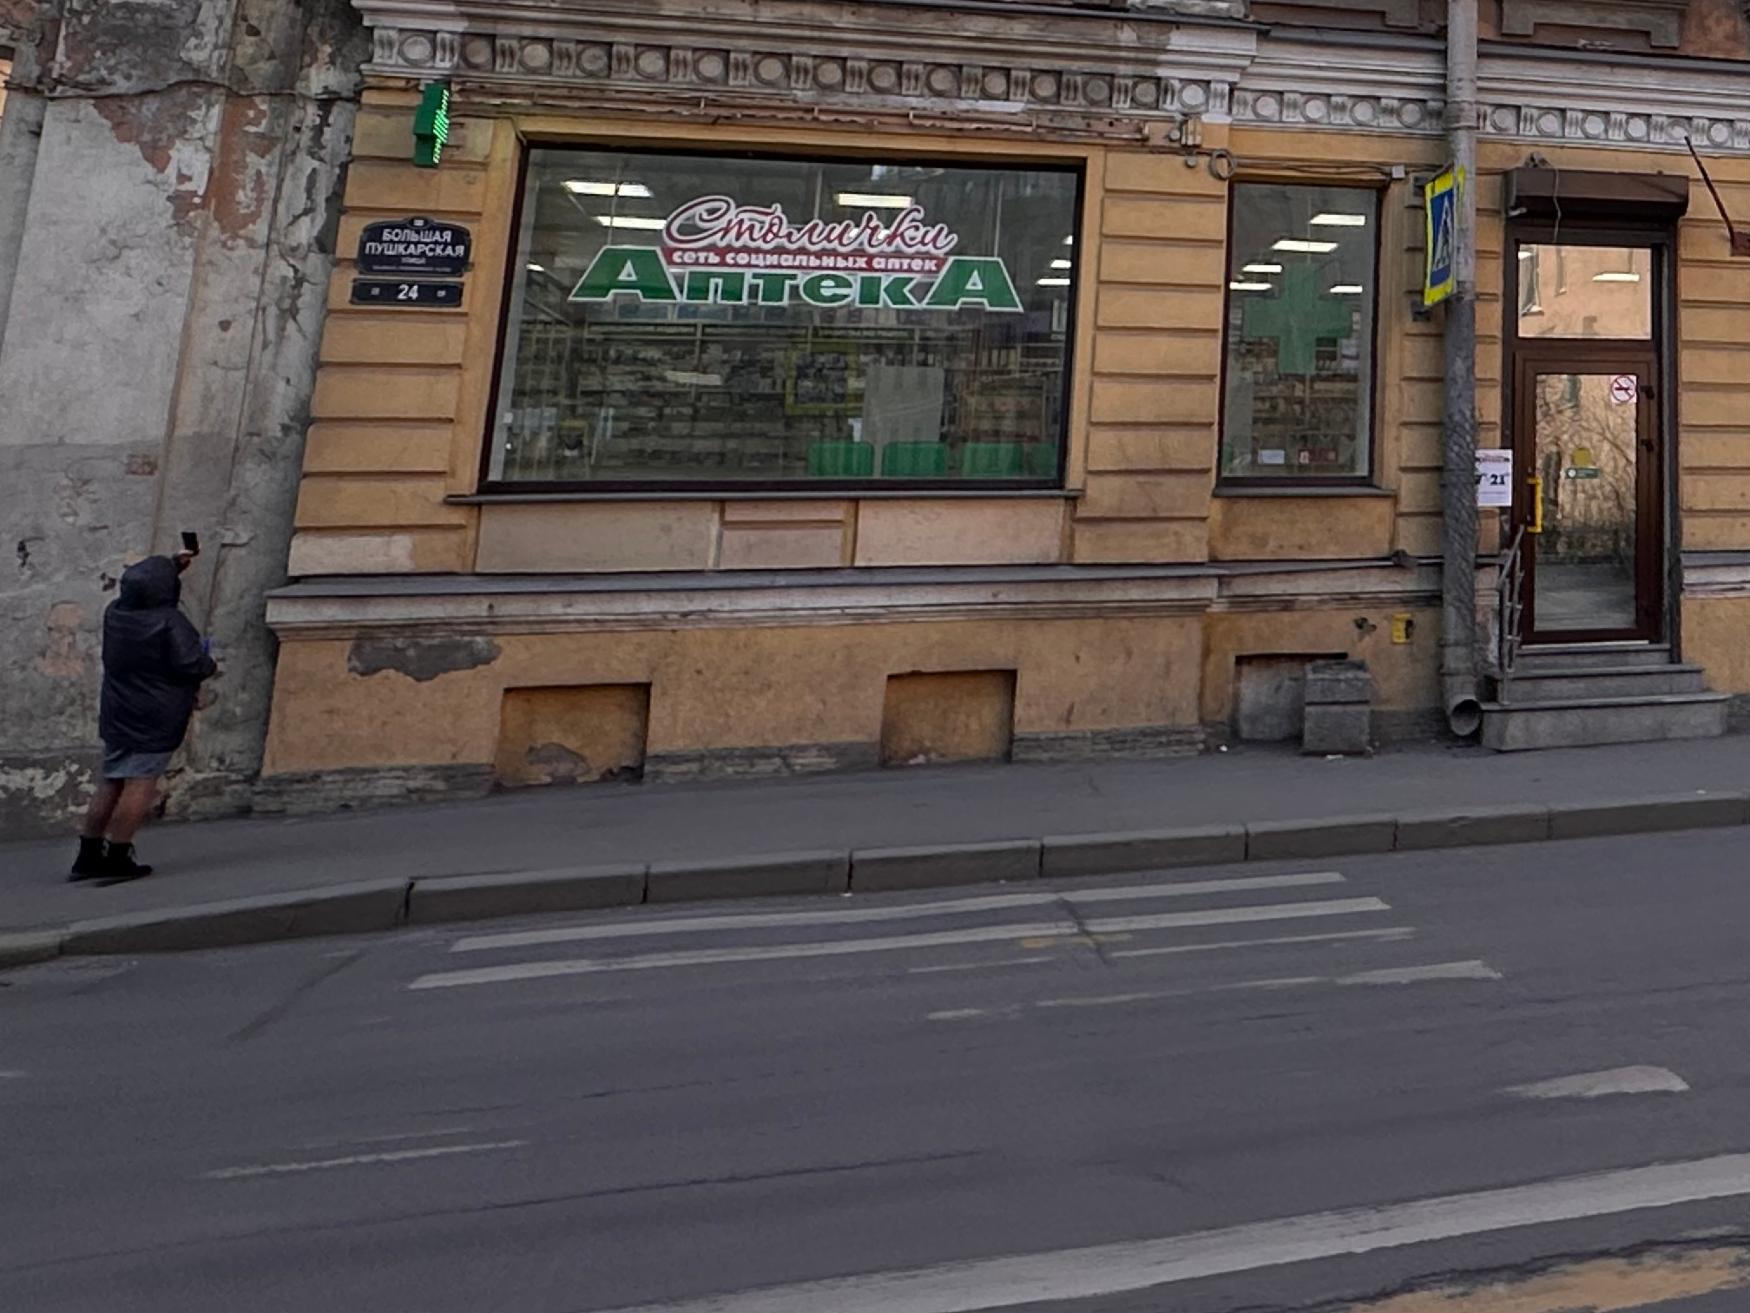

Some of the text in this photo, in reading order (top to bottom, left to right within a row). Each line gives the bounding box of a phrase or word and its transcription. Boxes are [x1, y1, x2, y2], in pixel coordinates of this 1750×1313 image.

[663, 195, 958, 254] Столички
[382, 228, 452, 242] БОЛЬШАЯ
[364, 242, 465, 256] ПУШКАРСКАЯ
[672, 251, 938, 272] сеть социальных аптек
[397, 284, 418, 300] 24
